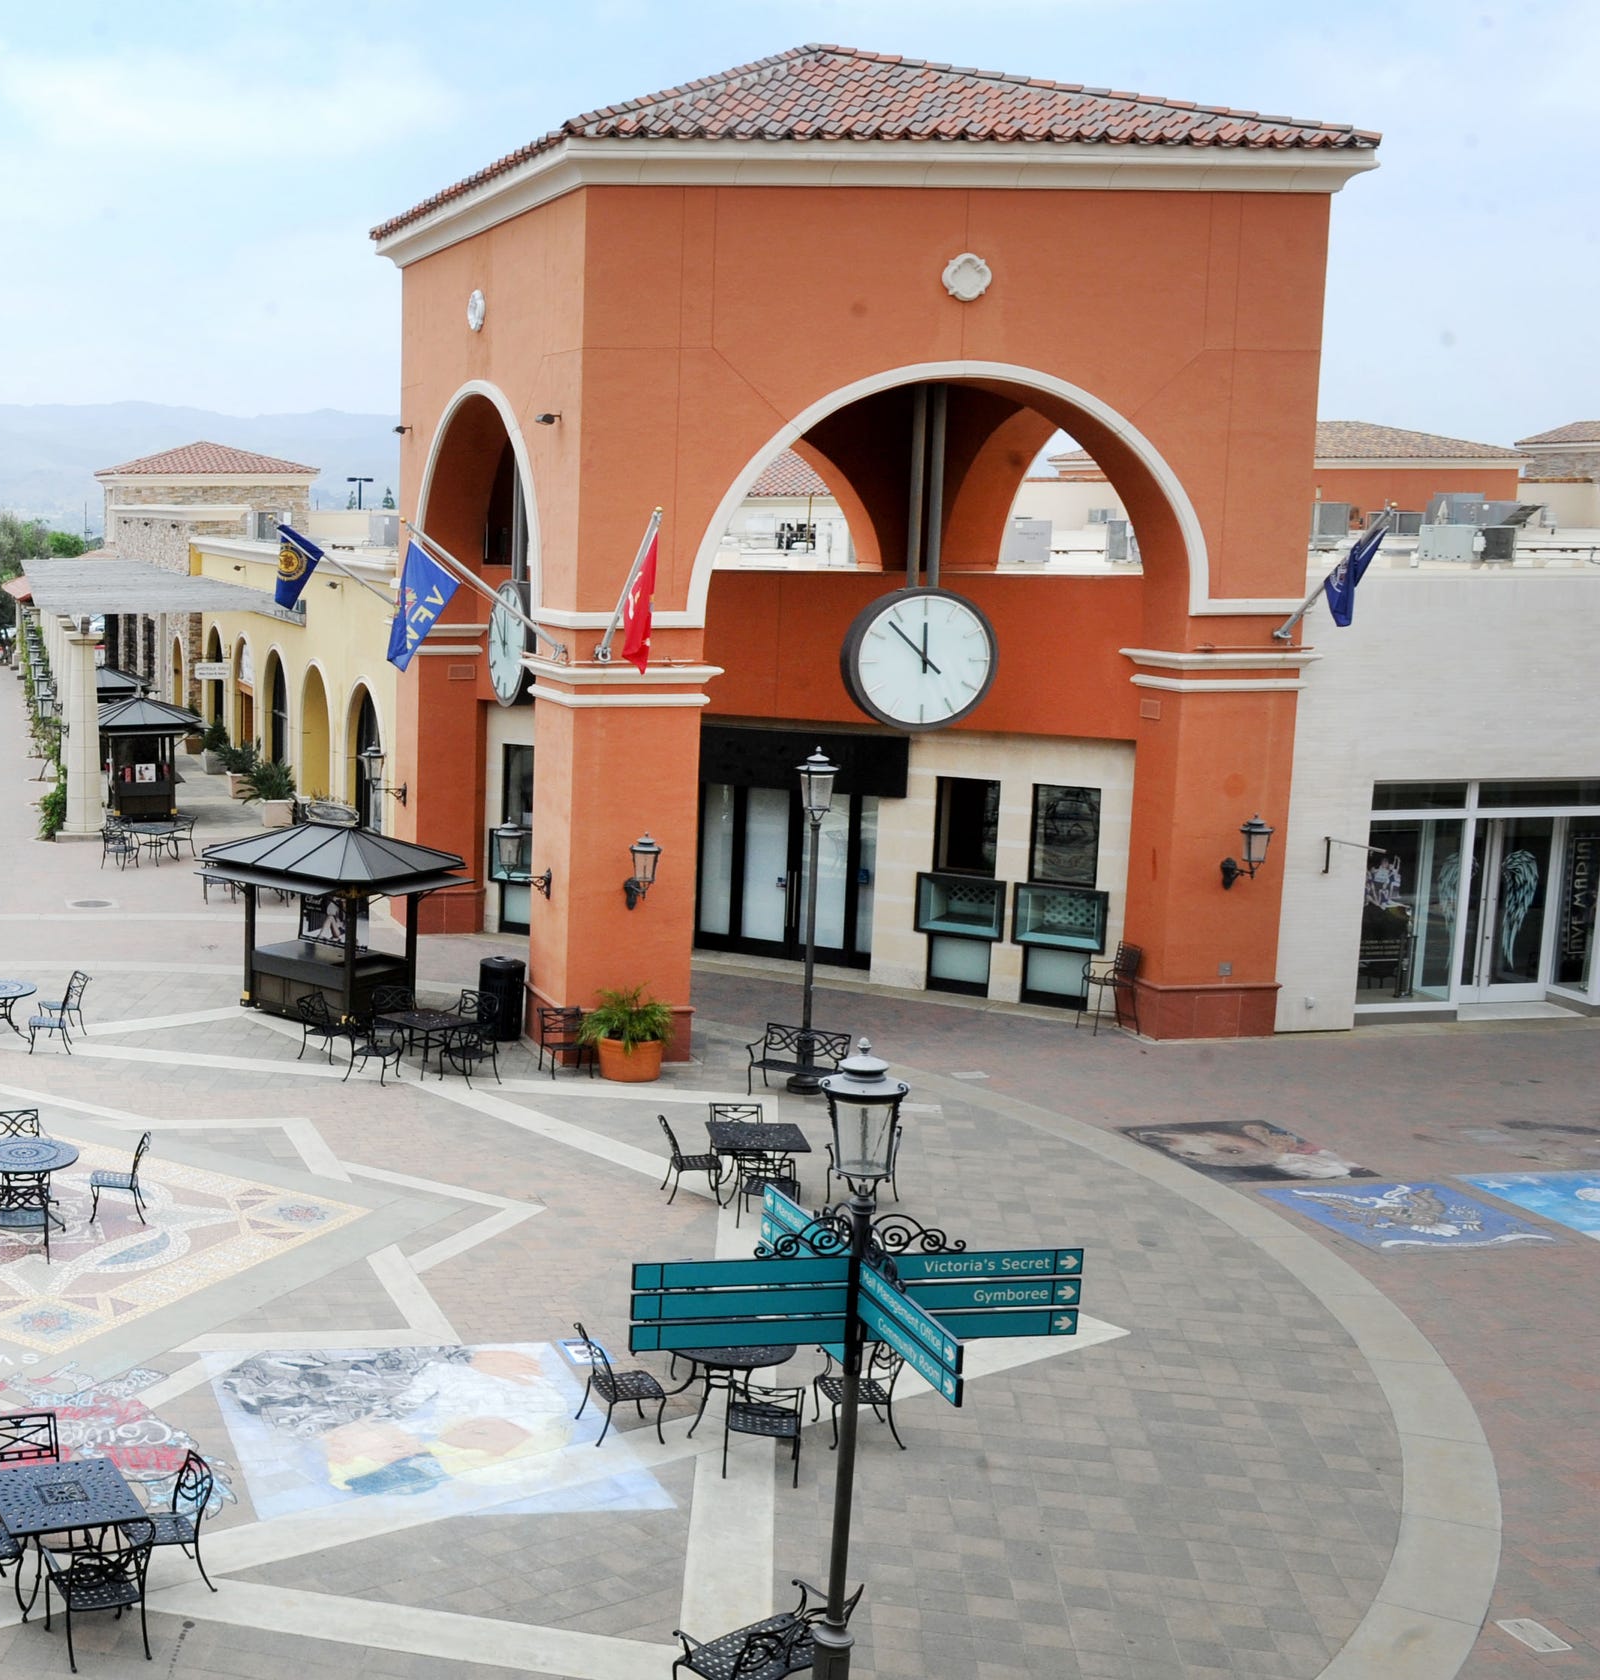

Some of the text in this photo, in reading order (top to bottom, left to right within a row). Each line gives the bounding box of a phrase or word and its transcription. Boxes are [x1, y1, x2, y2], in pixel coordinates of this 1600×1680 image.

[924, 1257, 1051, 1273] Victoria's Secret
[862, 1269, 943, 1350] Mall Management Office
[973, 1288, 1049, 1304] Gymboree
[877, 1317, 940, 1380] Community Room
